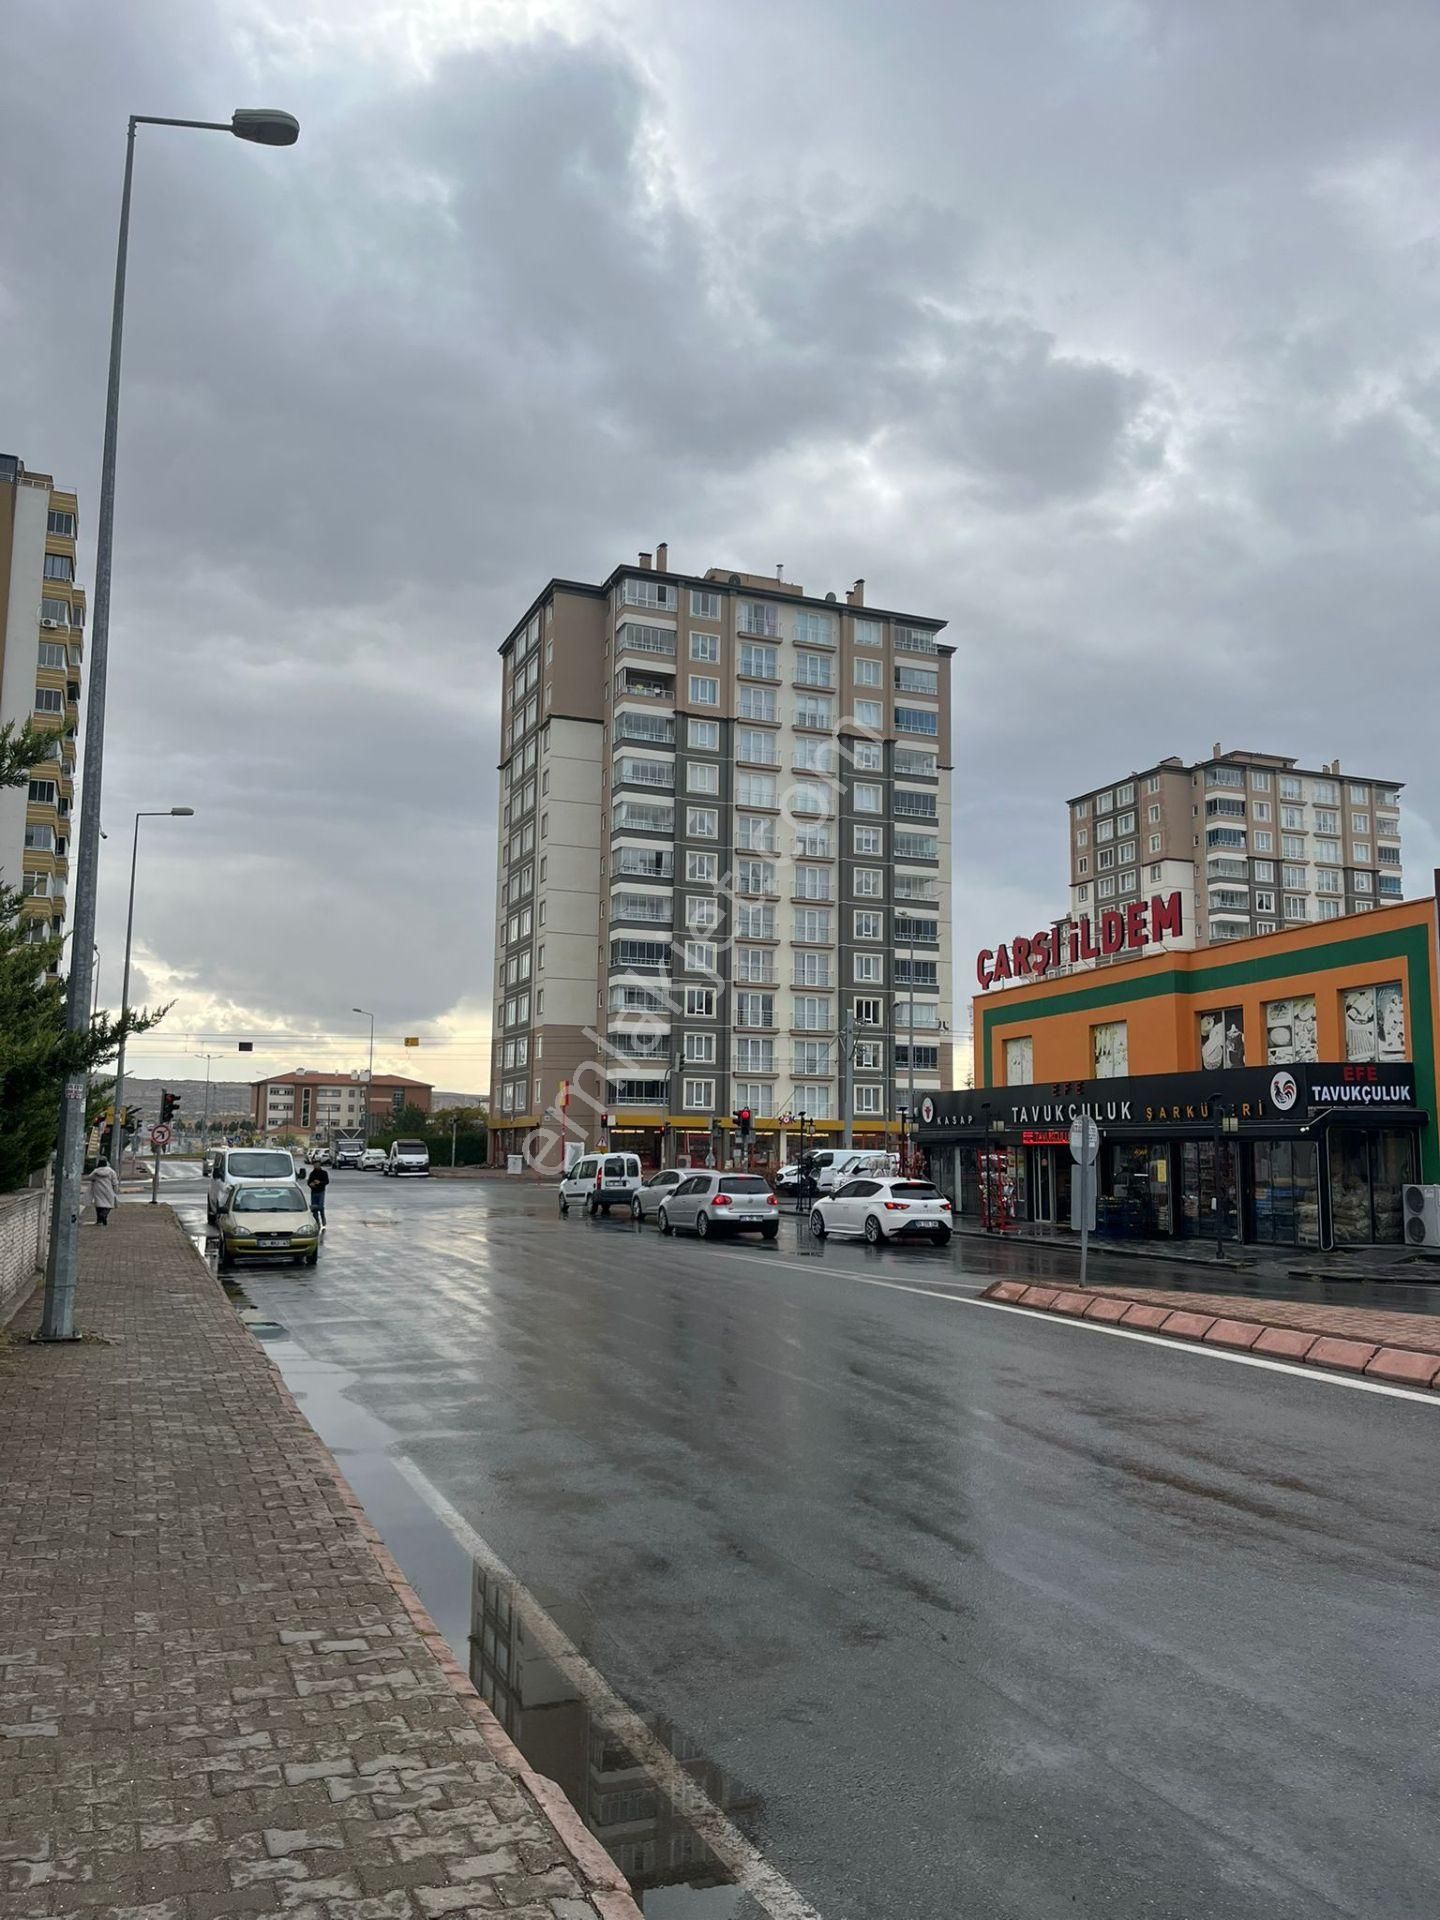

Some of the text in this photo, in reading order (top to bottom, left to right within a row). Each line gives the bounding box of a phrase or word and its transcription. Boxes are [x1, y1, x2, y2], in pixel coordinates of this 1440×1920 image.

[977, 927, 1061, 990] ÇARŞI
[1343, 1066, 1378, 1081] EFE
[1052, 1082, 1084, 1097] EFE
[1312, 1085, 1411, 1104] TAVUKÇULUK
[936, 1115, 974, 1126] KASAP
